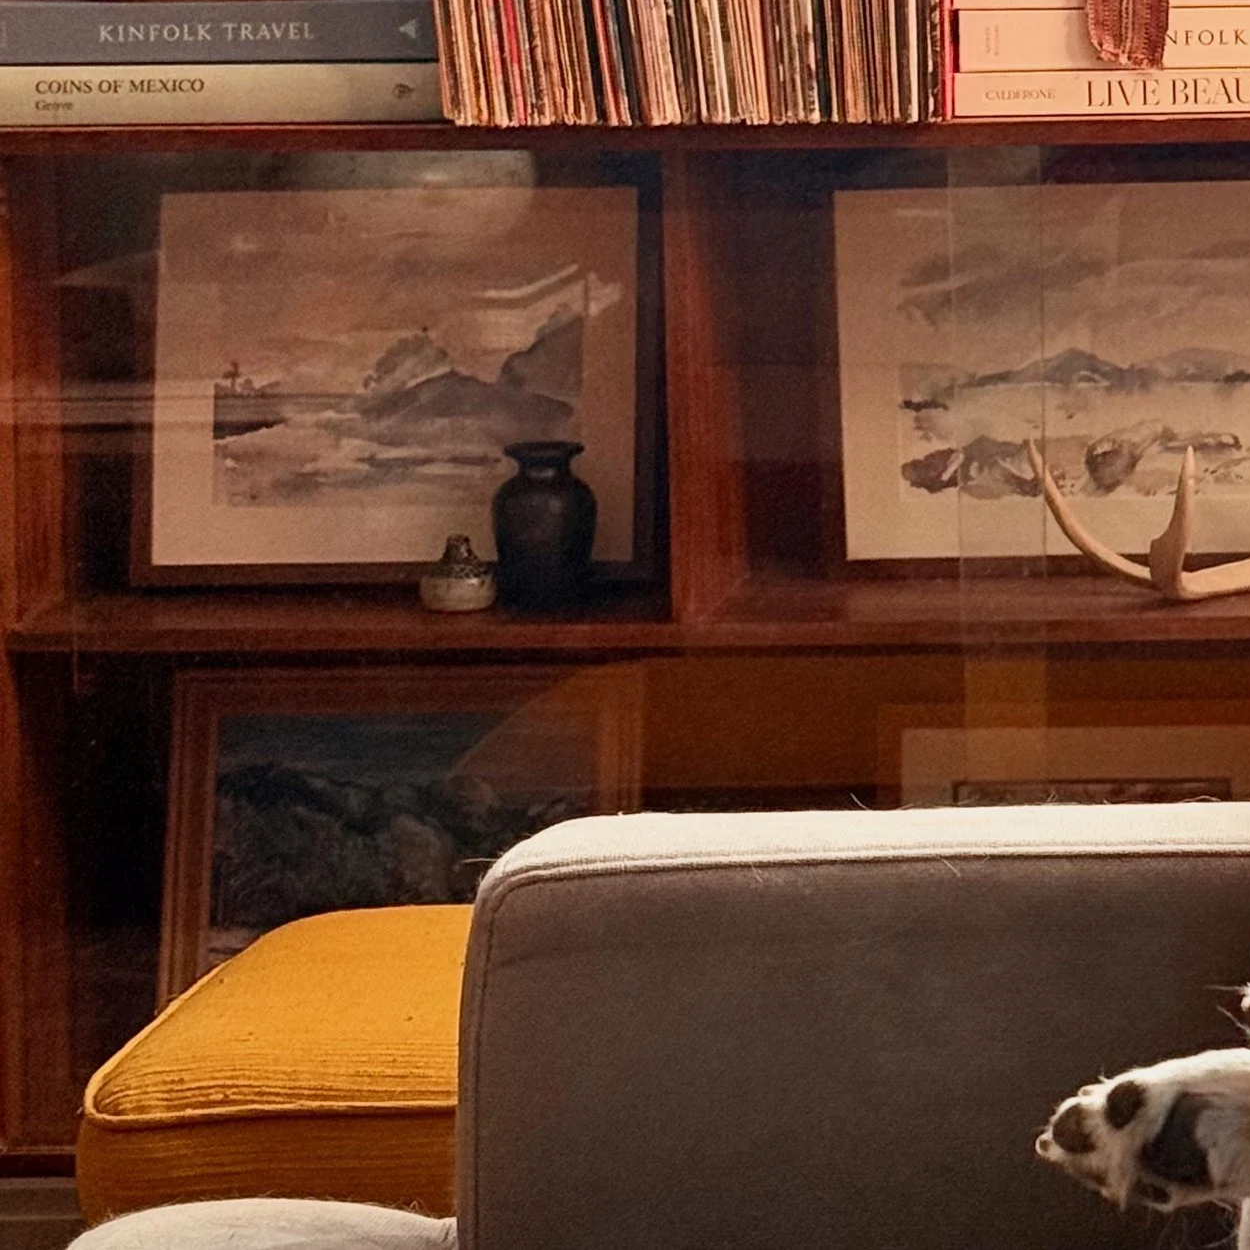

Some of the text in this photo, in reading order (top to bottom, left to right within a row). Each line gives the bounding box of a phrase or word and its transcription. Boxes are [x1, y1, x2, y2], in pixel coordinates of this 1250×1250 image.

[99, 21, 315, 43] KINFOLK TRAVEL
[1165, 28, 1248, 46] NFOLK
[35, 78, 205, 94] COINS OF MEXICO
[984, 88, 1056, 100] CALDERONE
[1087, 78, 1161, 107] LIVE
